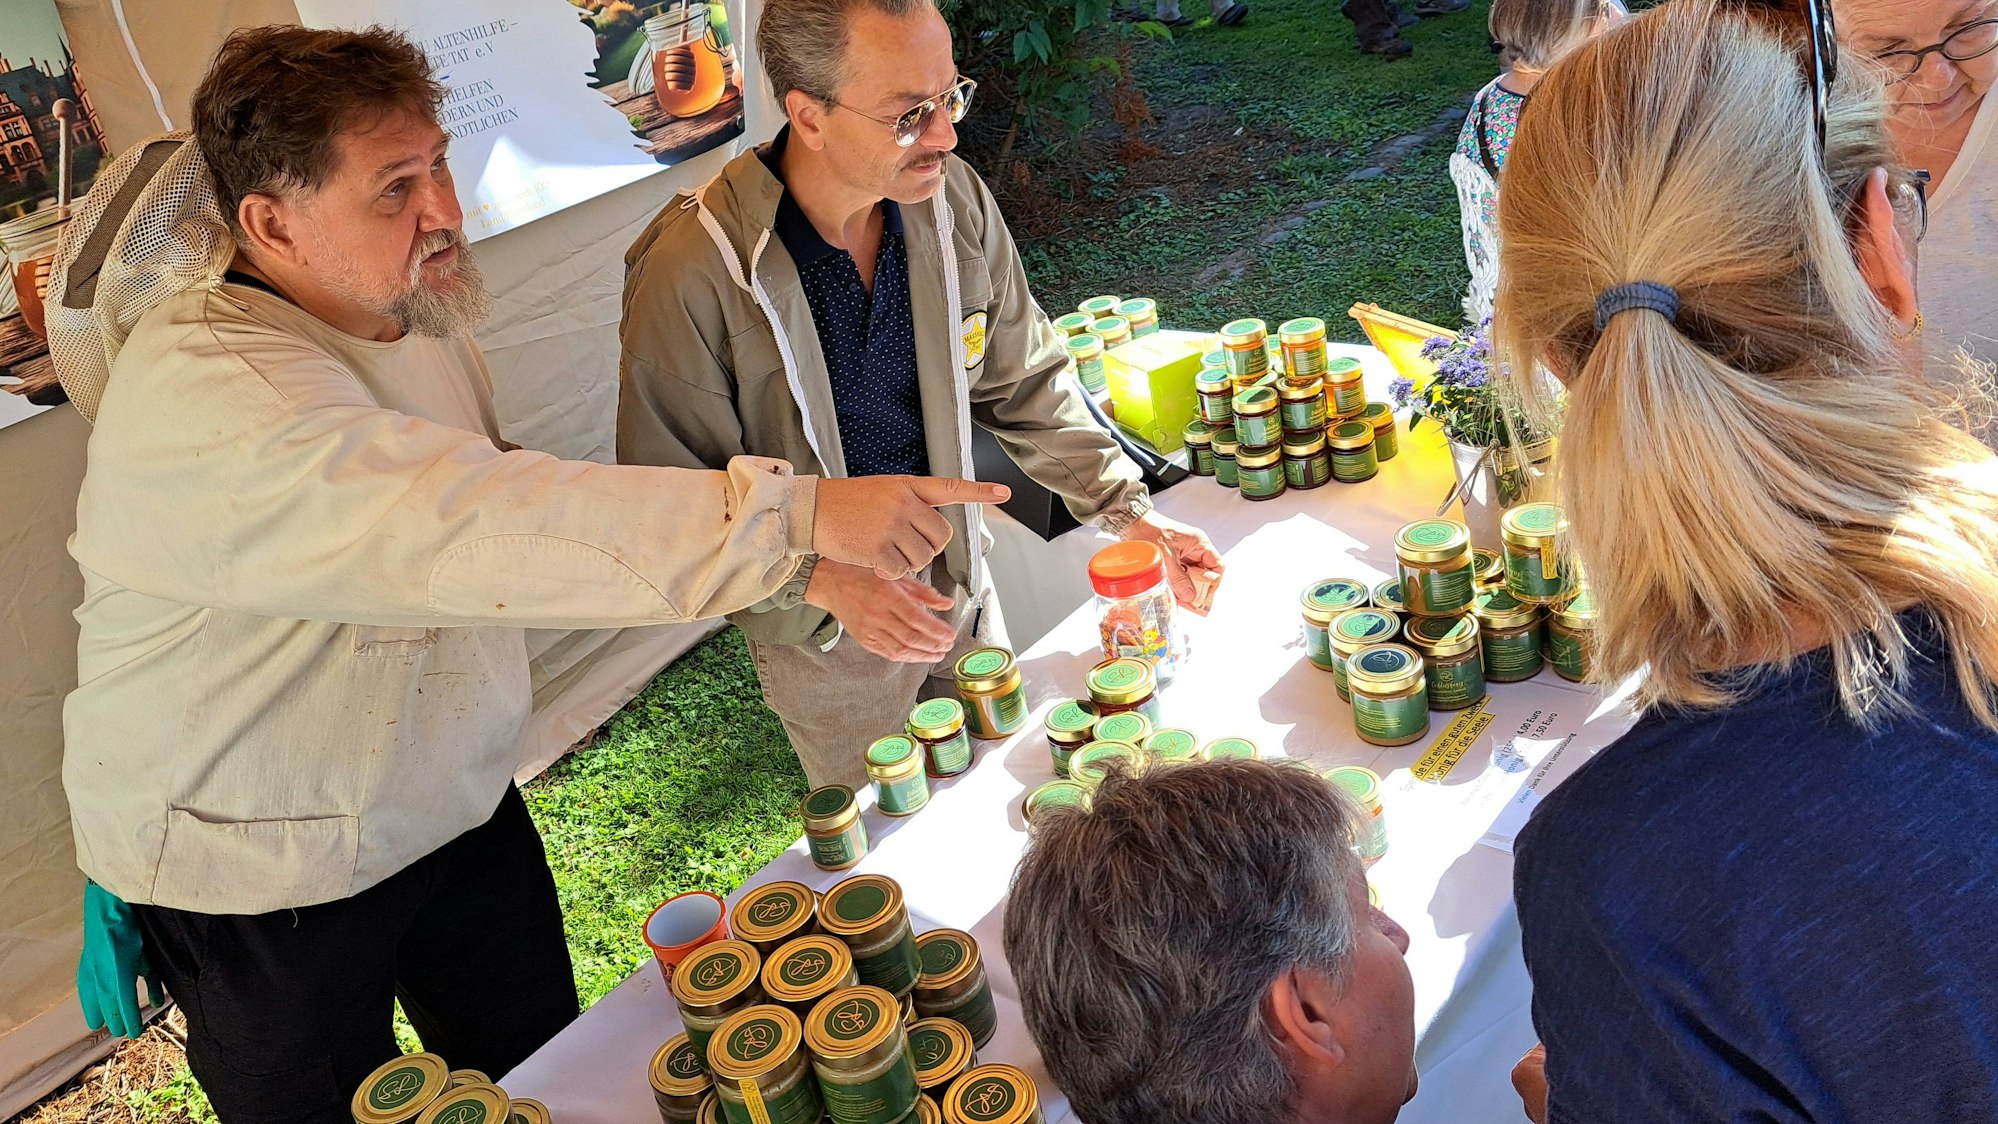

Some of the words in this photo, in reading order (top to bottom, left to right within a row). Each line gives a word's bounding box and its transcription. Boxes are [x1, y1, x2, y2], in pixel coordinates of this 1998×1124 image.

[433, 19, 509, 51] ALTENHILFE
[448, 47, 470, 65] TAT
[446, 78, 494, 104] HELFEN
[441, 101, 476, 124] DERN
[477, 94, 504, 113] UND
[1517, 722, 1531, 735] 4,00
[1526, 710, 1542, 723] Euro
[1531, 725, 1547, 738] 7,50
[1542, 712, 1558, 726] Euro
[1420, 756, 1436, 767] für
[1432, 737, 1453, 757] einen
[1448, 719, 1469, 739] guten
[1446, 747, 1463, 760] für
[1457, 735, 1473, 748] die
[1466, 716, 1489, 736] Seele
[1528, 777, 1541, 790] Dank
